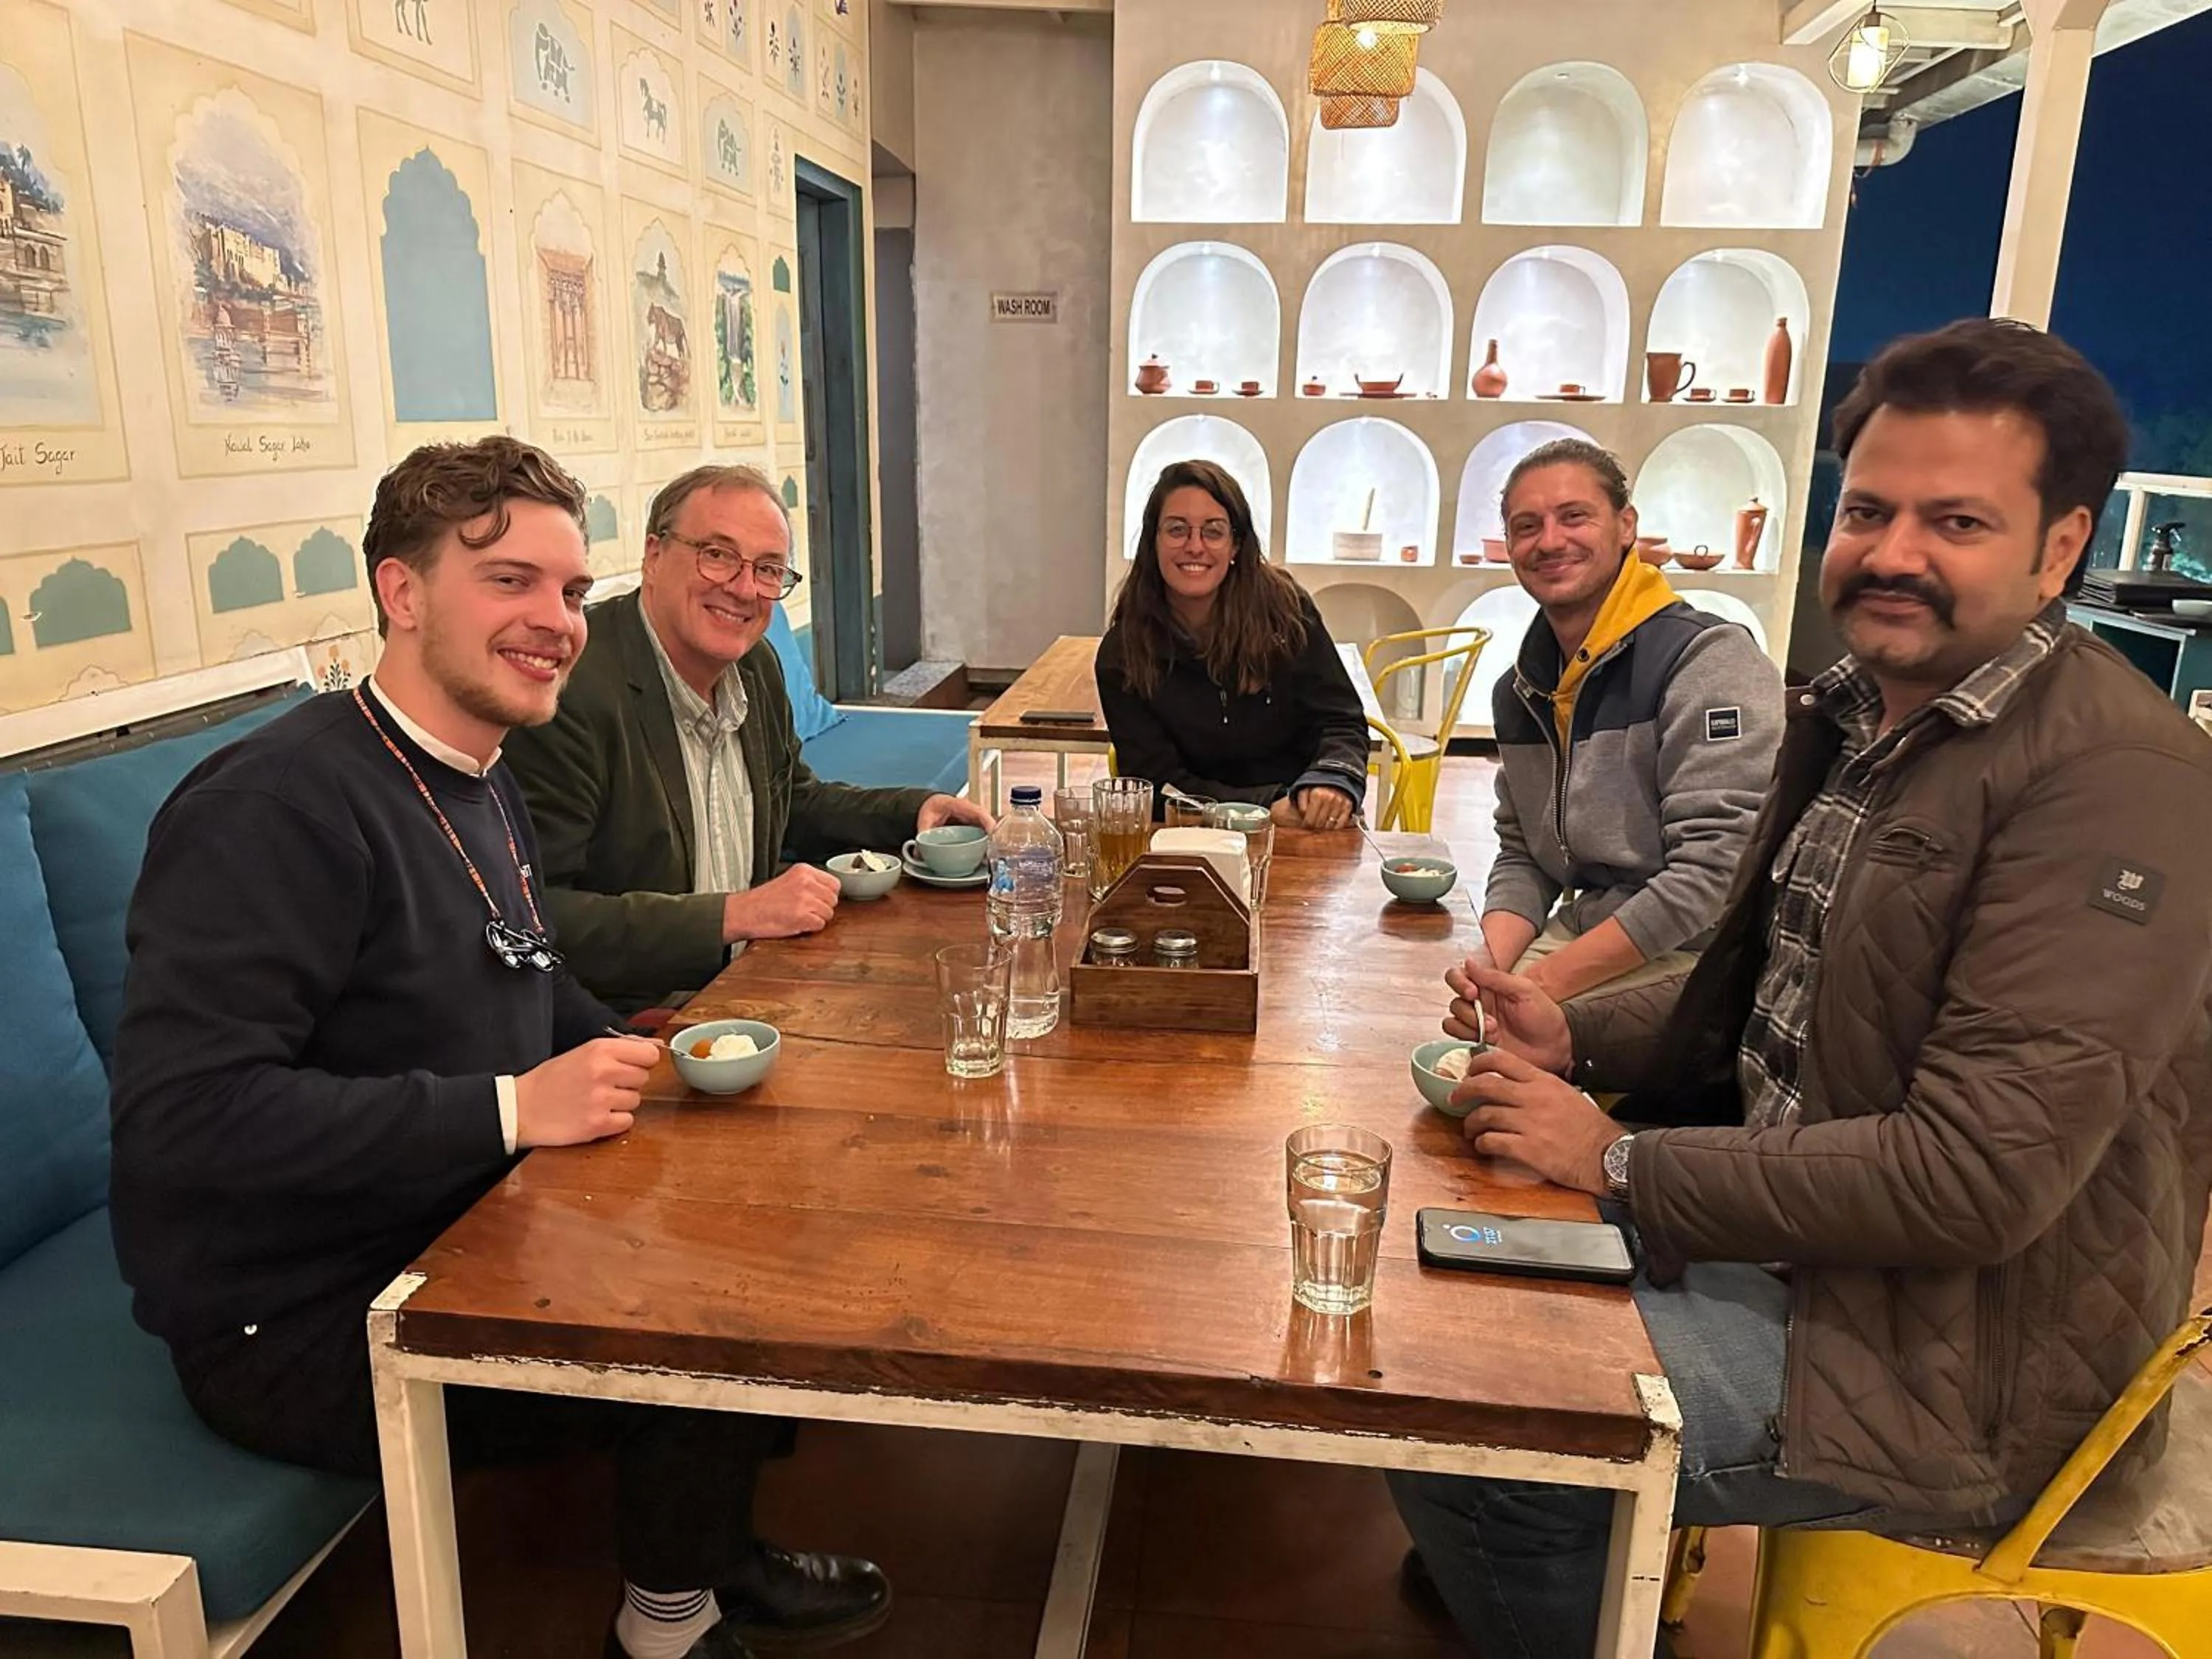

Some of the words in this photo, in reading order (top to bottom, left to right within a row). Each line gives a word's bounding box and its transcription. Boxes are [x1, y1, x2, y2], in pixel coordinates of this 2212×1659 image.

[998, 299, 1023, 315] WASH
[1024, 299, 1051, 316] ROOM
[35, 442, 74, 475] Sagar
